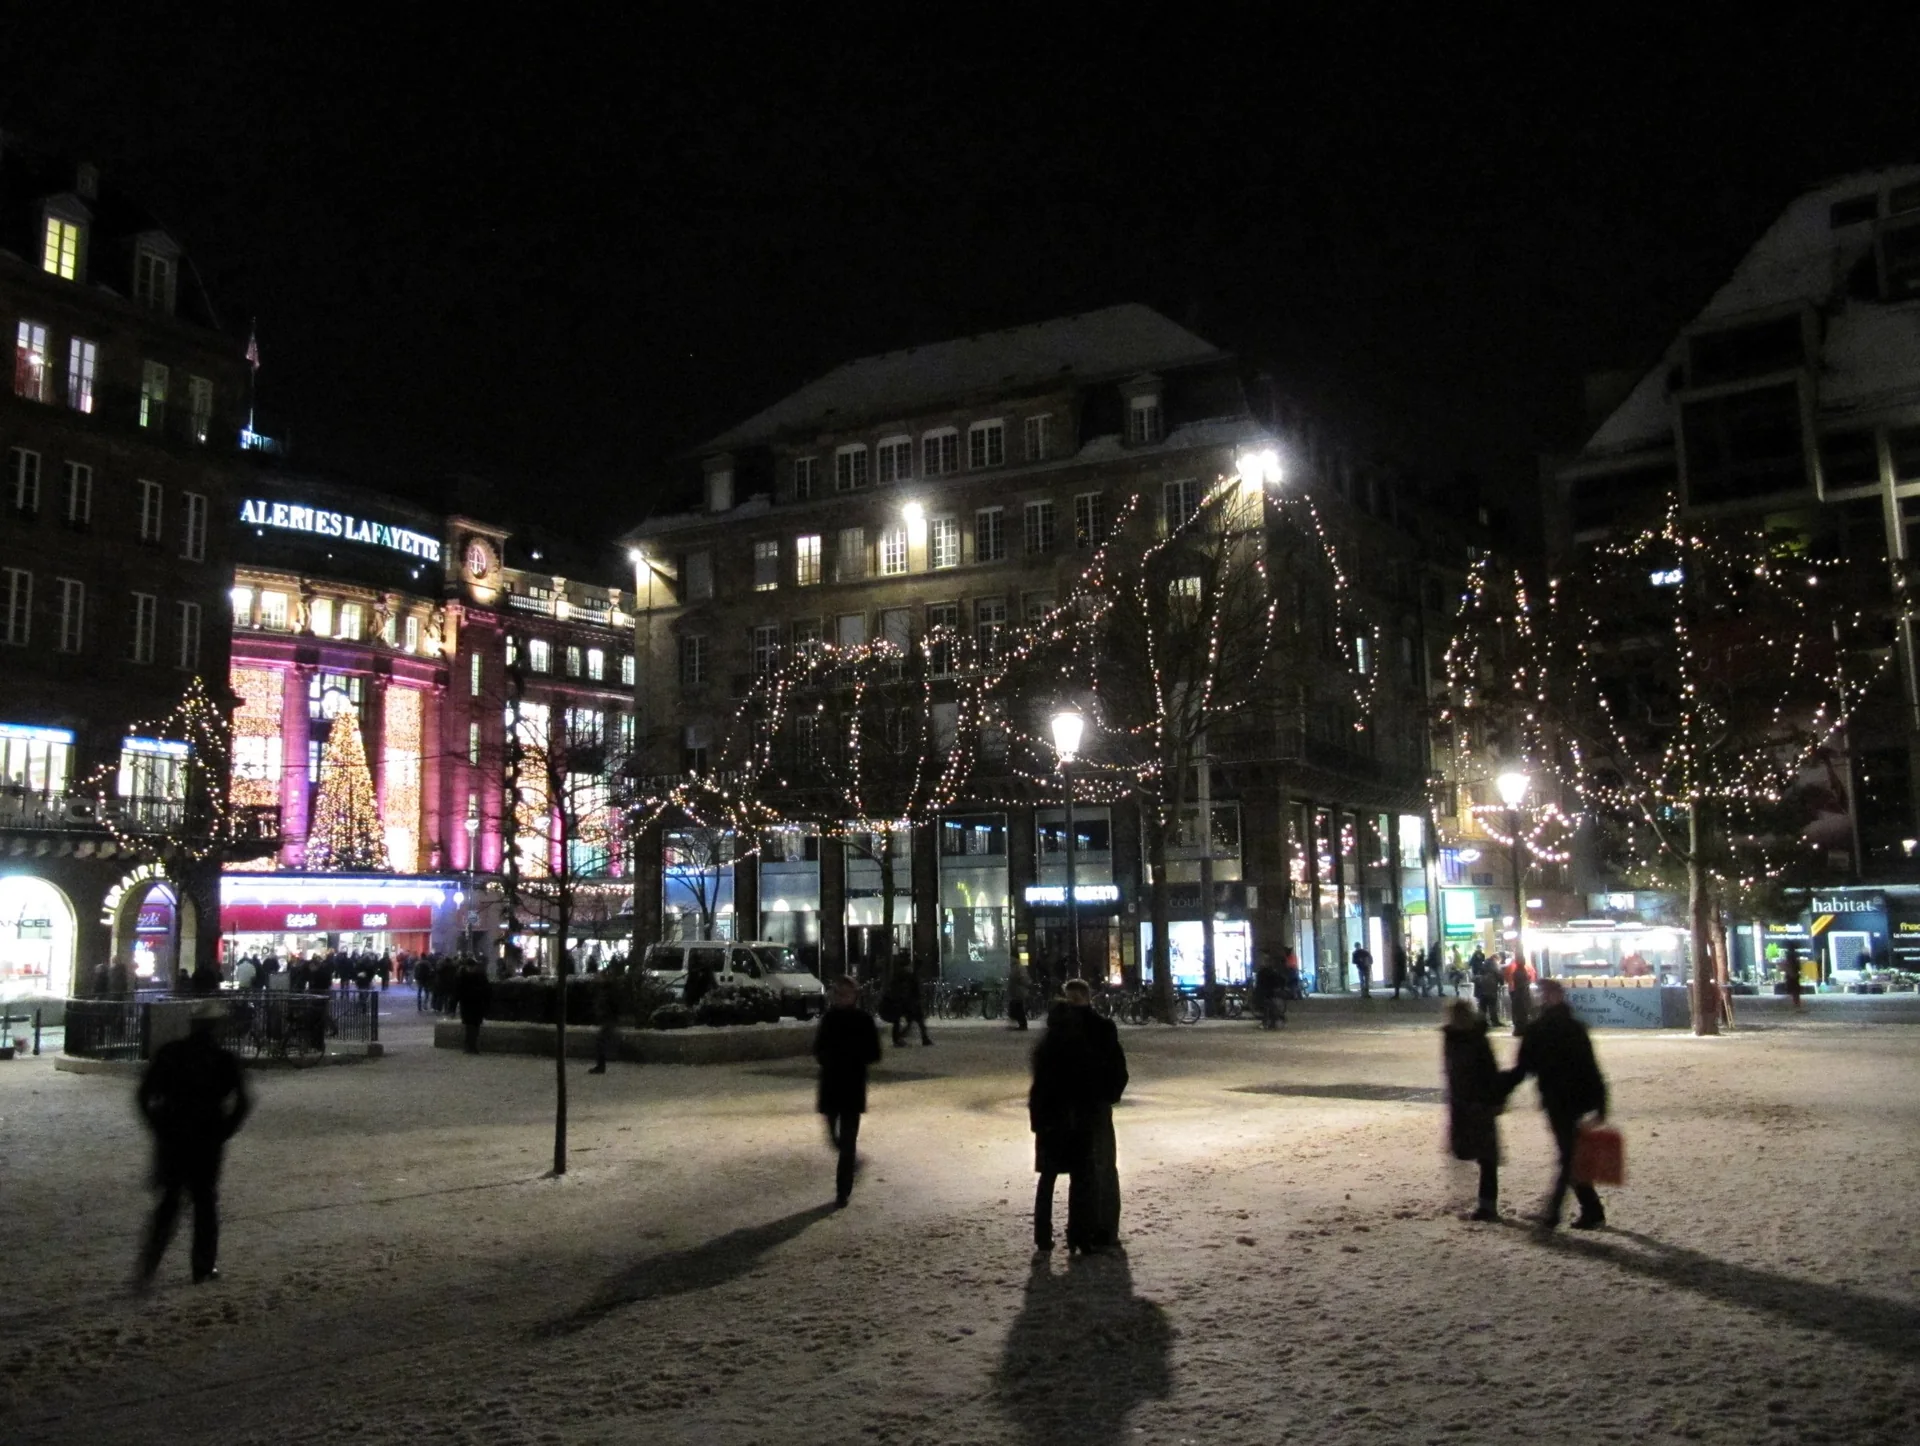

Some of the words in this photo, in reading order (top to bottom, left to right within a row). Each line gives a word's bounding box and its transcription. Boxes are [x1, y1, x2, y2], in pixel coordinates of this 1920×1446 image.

[240, 499, 343, 537] ALERIES
[344, 515, 440, 562] LAFAYETTE
[1812, 897, 1872, 912] habitat
[1602, 989, 1661, 1025] SPECIALES
